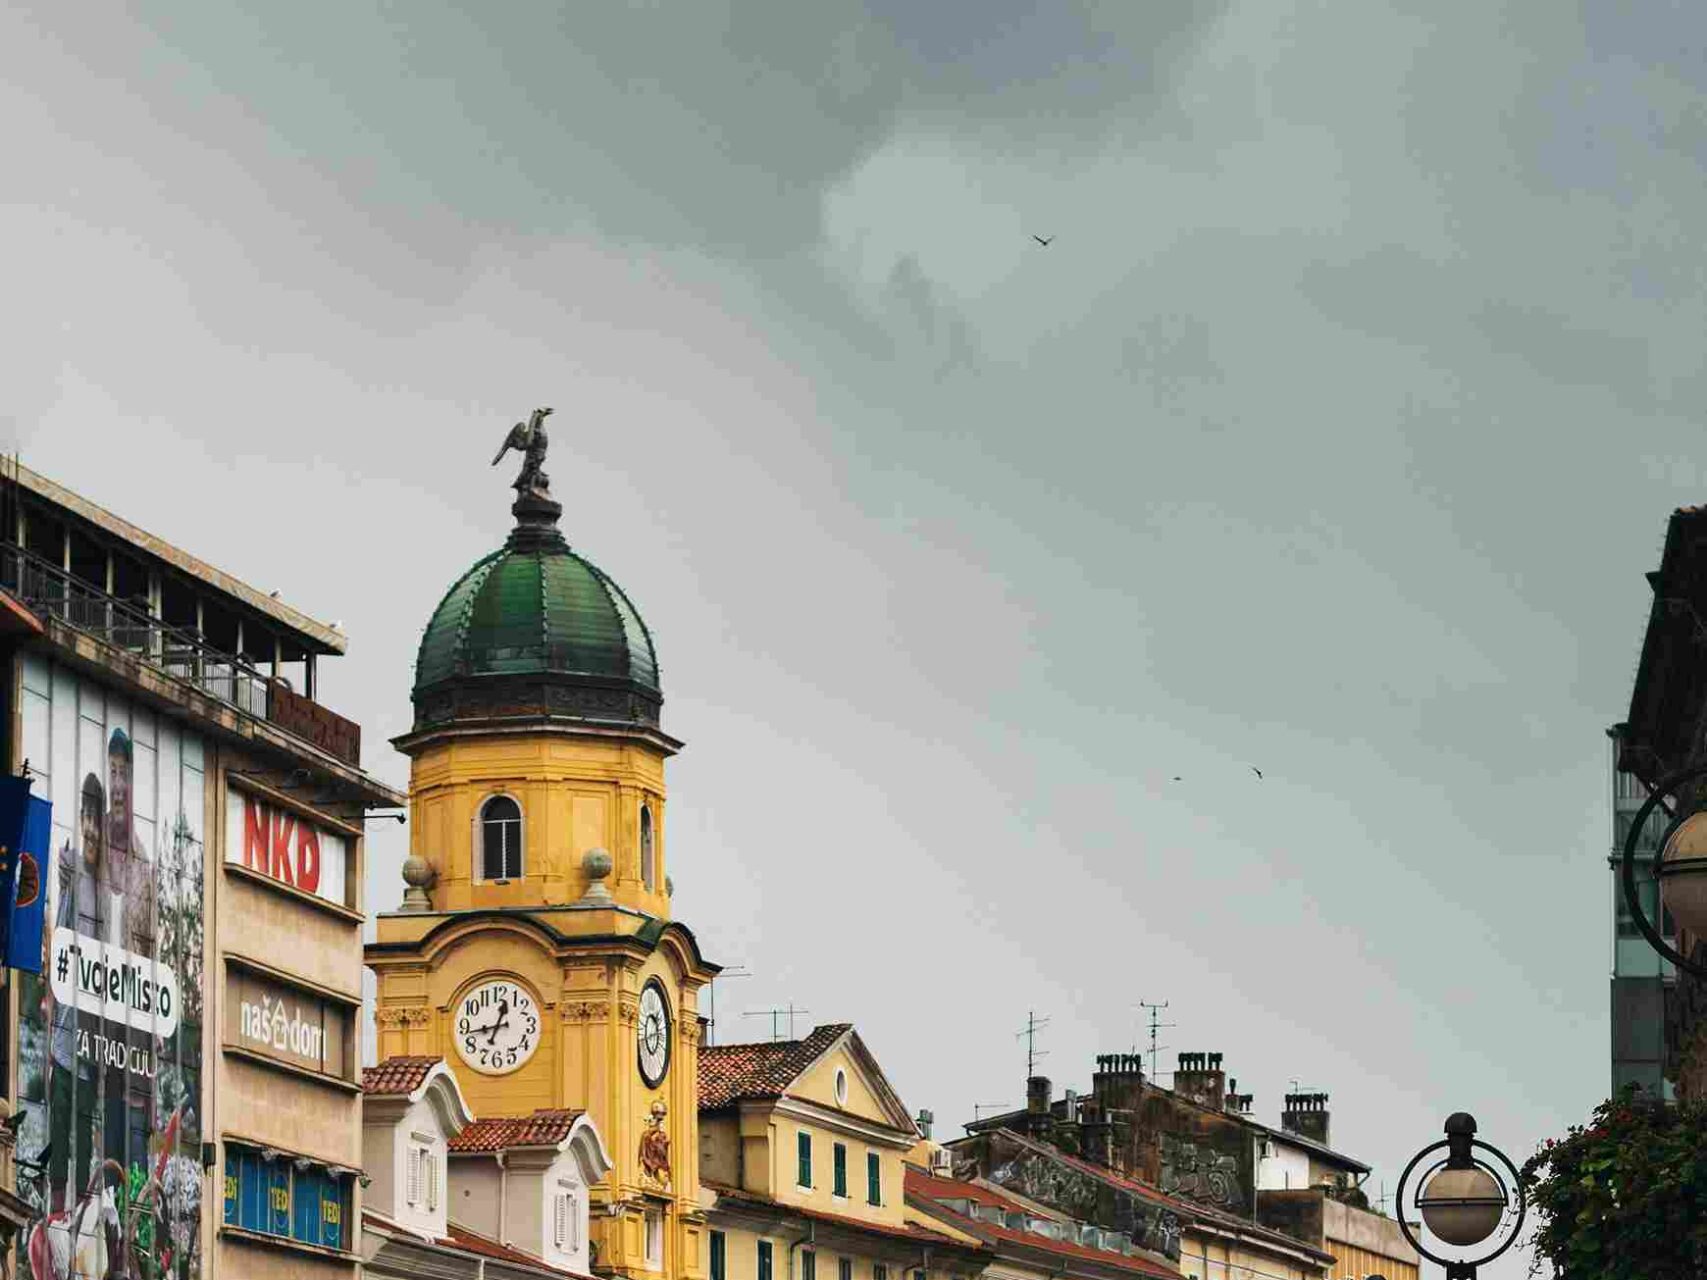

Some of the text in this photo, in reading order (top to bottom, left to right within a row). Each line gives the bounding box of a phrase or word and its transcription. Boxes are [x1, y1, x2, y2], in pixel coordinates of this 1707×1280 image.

[244, 801, 320, 894] NKD
[480, 990, 489, 1007] 11
[493, 986, 507, 1003] 12
[513, 991, 518, 1007] 1
[466, 999, 479, 1016] 10
[520, 998, 529, 1016] 2
[241, 993, 326, 1061] naš dom
[459, 1018, 470, 1035] 9
[526, 1016, 536, 1034] 3
[465, 1036, 476, 1054] 8
[519, 1034, 529, 1051] 4
[94, 1035, 158, 1078] TRADCIJU
[480, 1048, 489, 1065] 7
[491, 1051, 503, 1068] 6
[507, 1047, 517, 1064] 5
